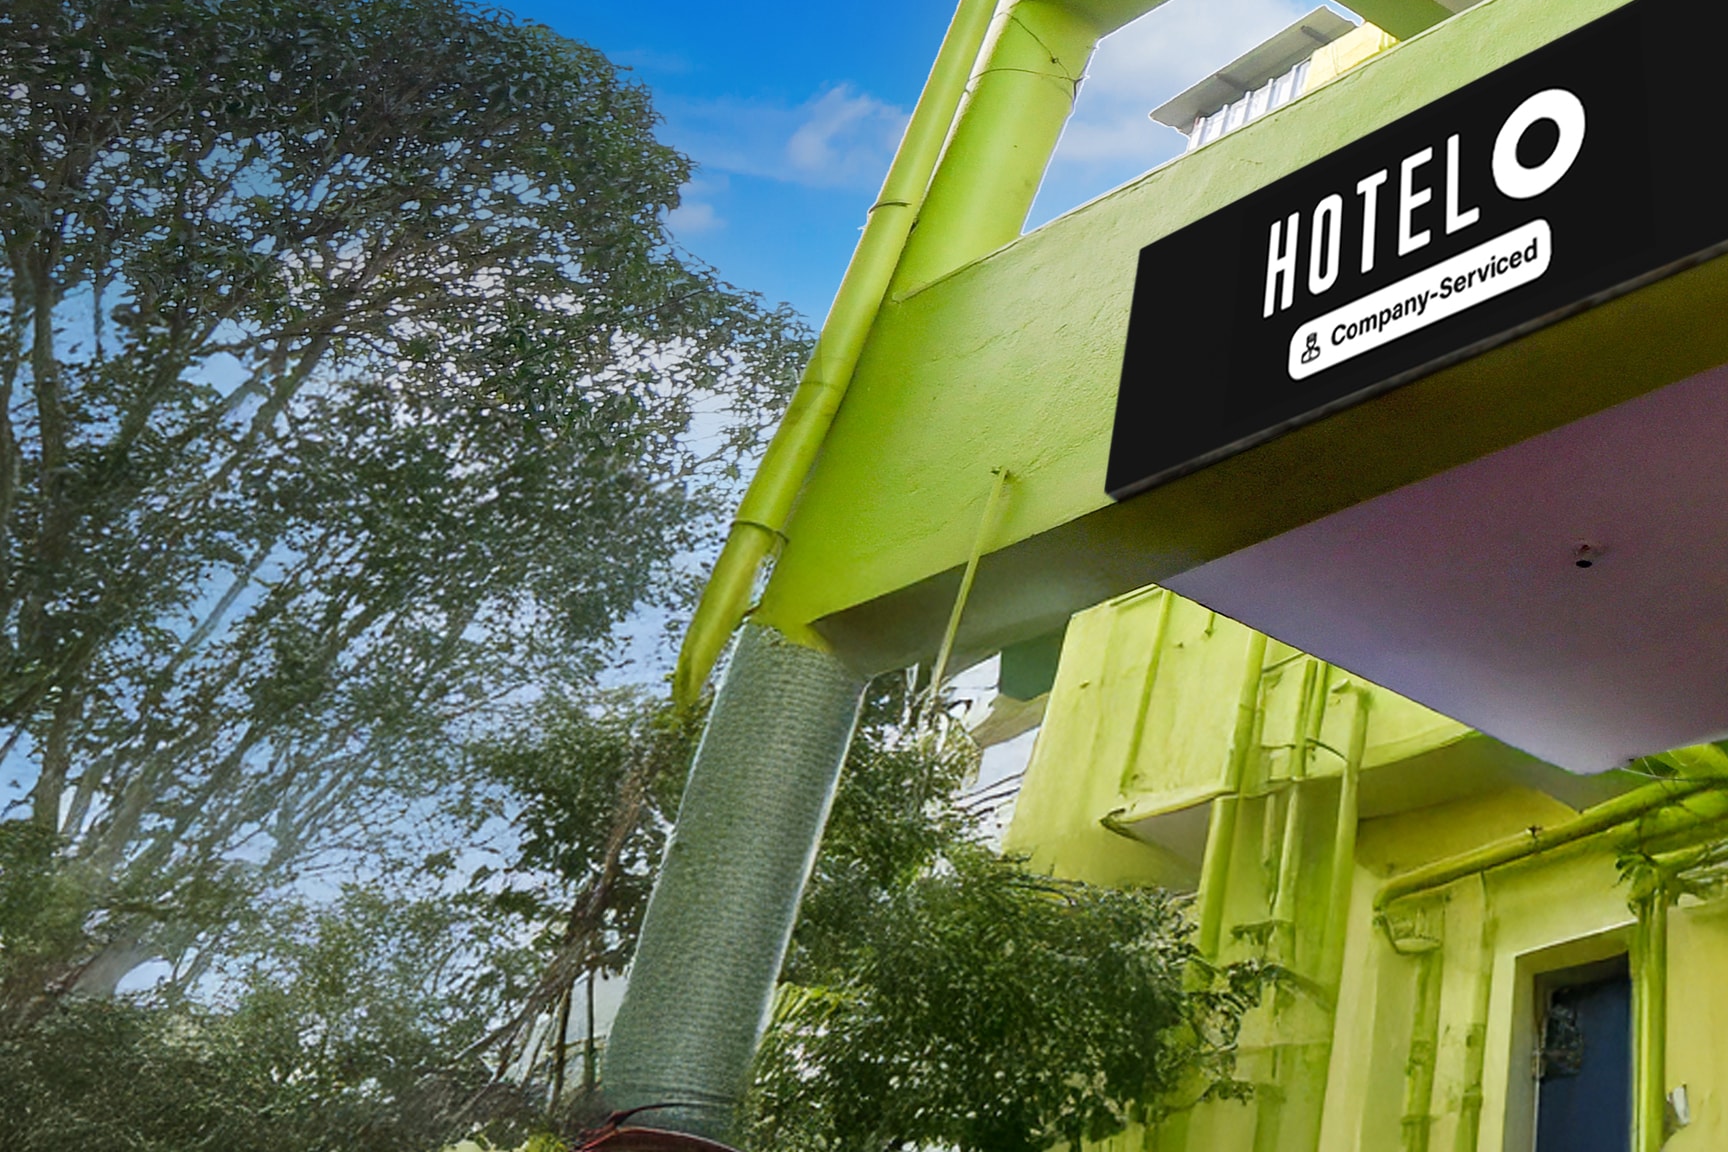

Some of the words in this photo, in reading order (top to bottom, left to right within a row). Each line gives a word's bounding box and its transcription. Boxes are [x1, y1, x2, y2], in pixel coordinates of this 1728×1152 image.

[1263, 134, 1480, 318] HOTEL
[1492, 88, 1586, 199] O
[1331, 237, 1538, 346] Company-Serviced
